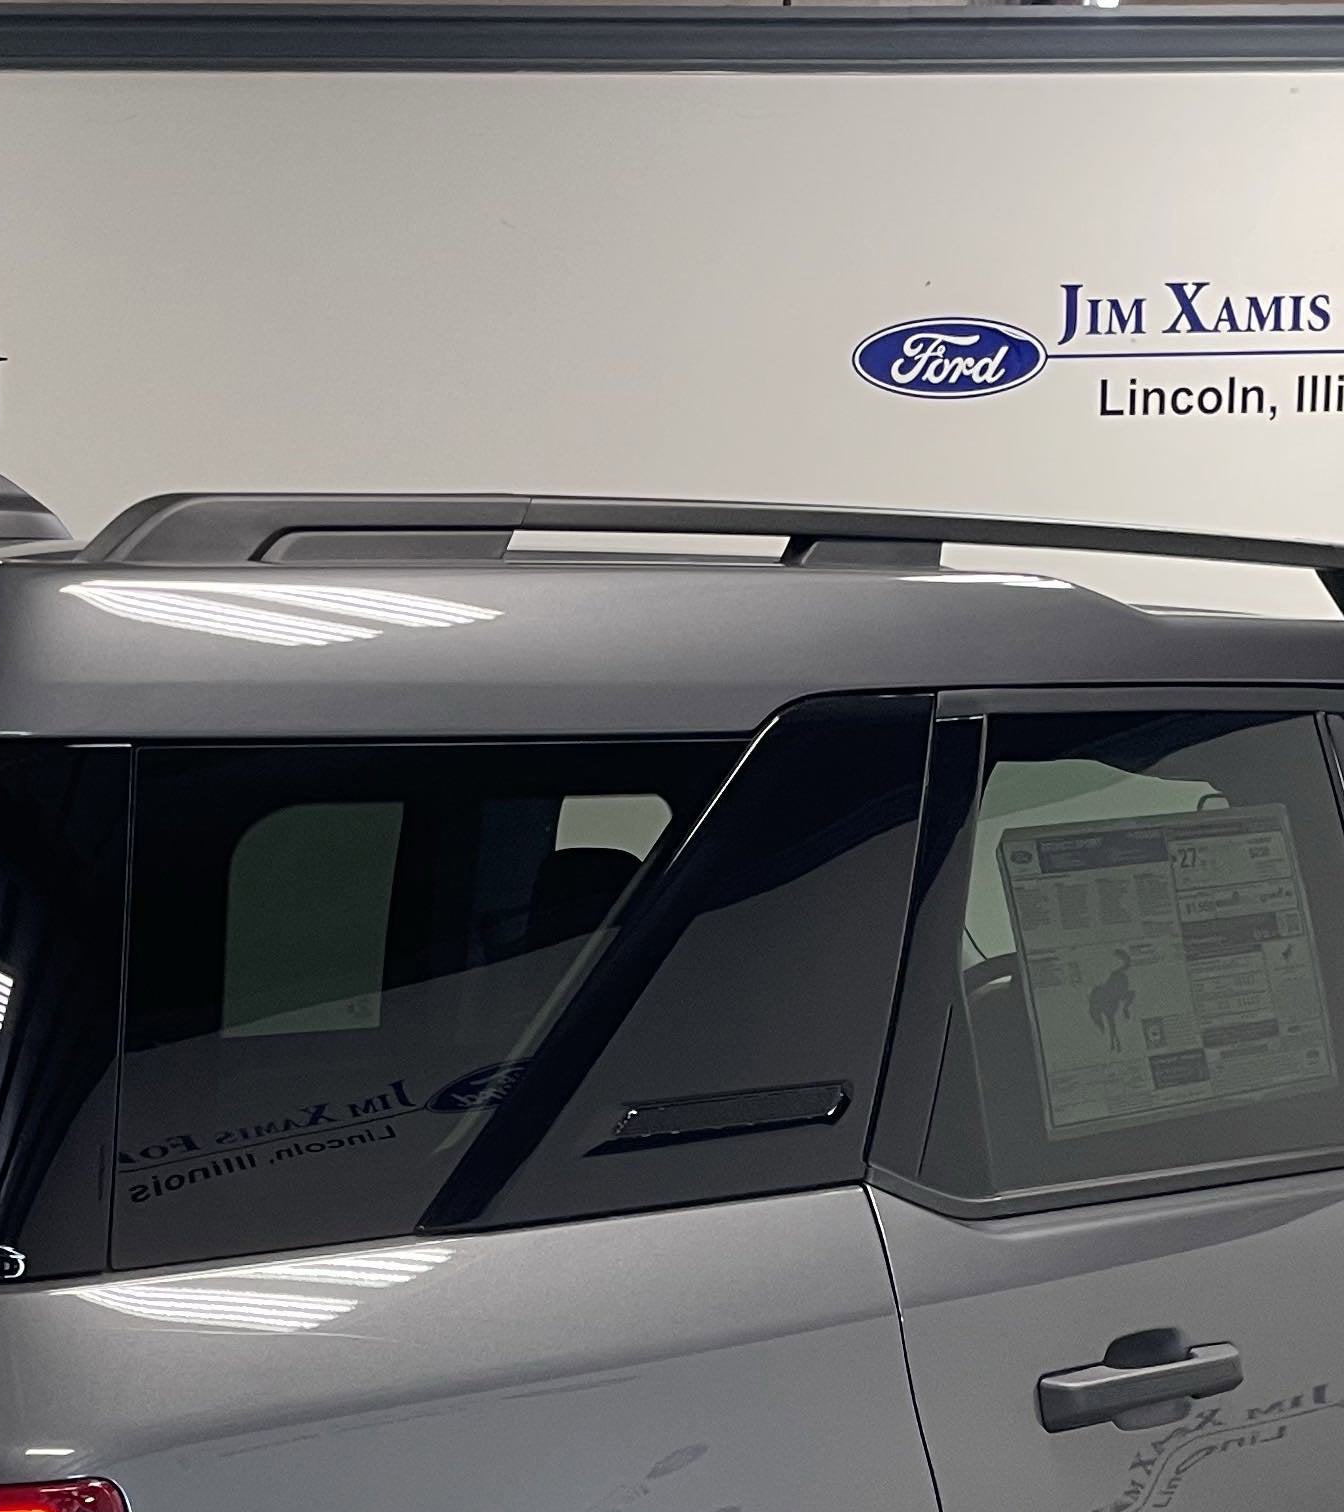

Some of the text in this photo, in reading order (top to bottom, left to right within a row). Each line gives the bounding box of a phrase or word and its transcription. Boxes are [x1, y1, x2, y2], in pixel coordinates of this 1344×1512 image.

[1057, 284, 1146, 345] JIM
[1163, 282, 1331, 334] XAMIS
[890, 333, 1009, 384] Ford
[1099, 376, 1278, 421] Lincoln,
